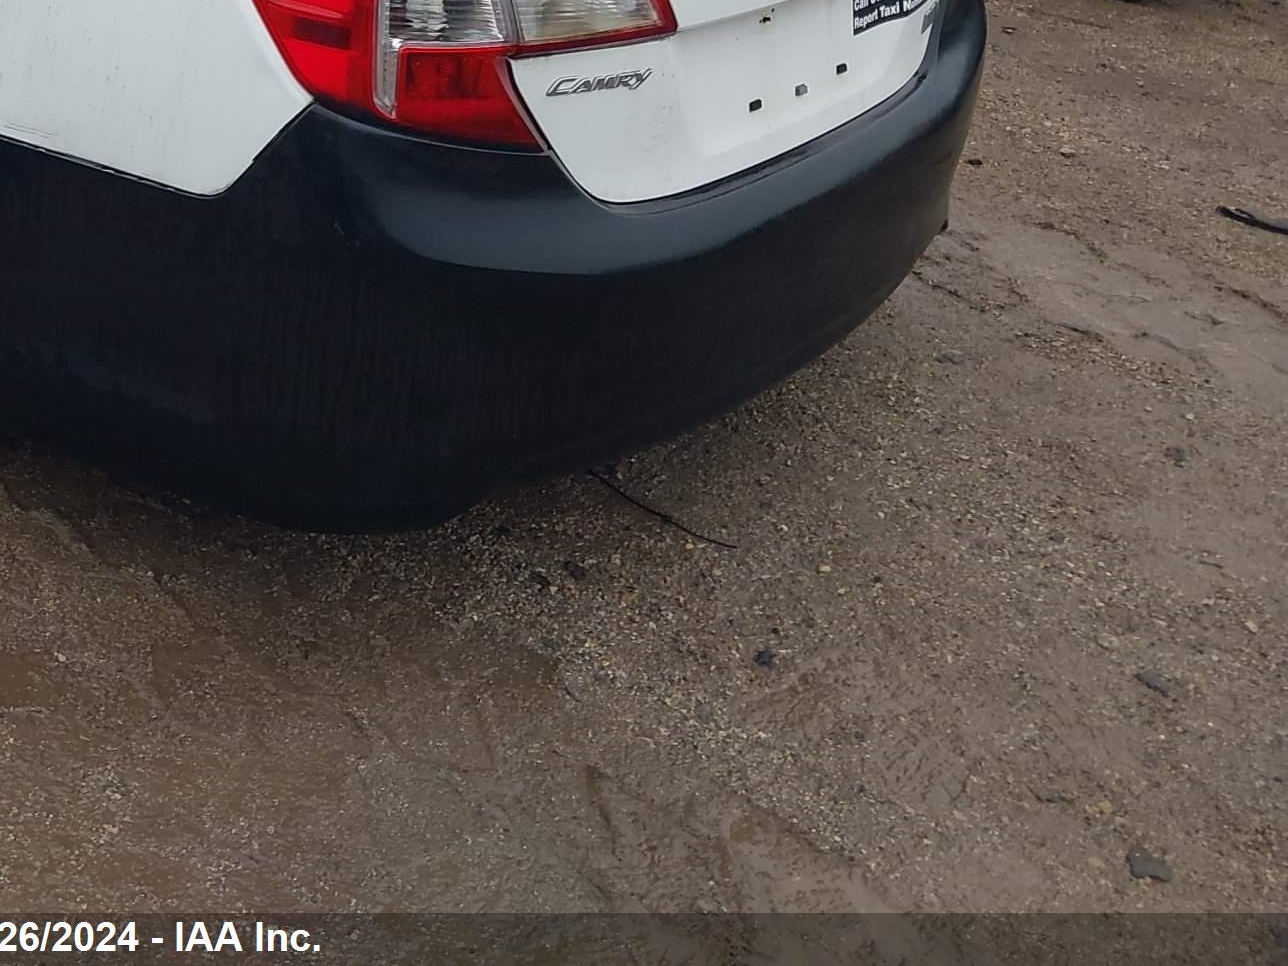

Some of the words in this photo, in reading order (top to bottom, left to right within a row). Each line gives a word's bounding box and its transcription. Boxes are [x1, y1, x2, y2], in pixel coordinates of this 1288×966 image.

[854, 8, 879, 30] Report
[879, 0, 900, 18] Taxi
[545, 66, 655, 97] CAMRY
